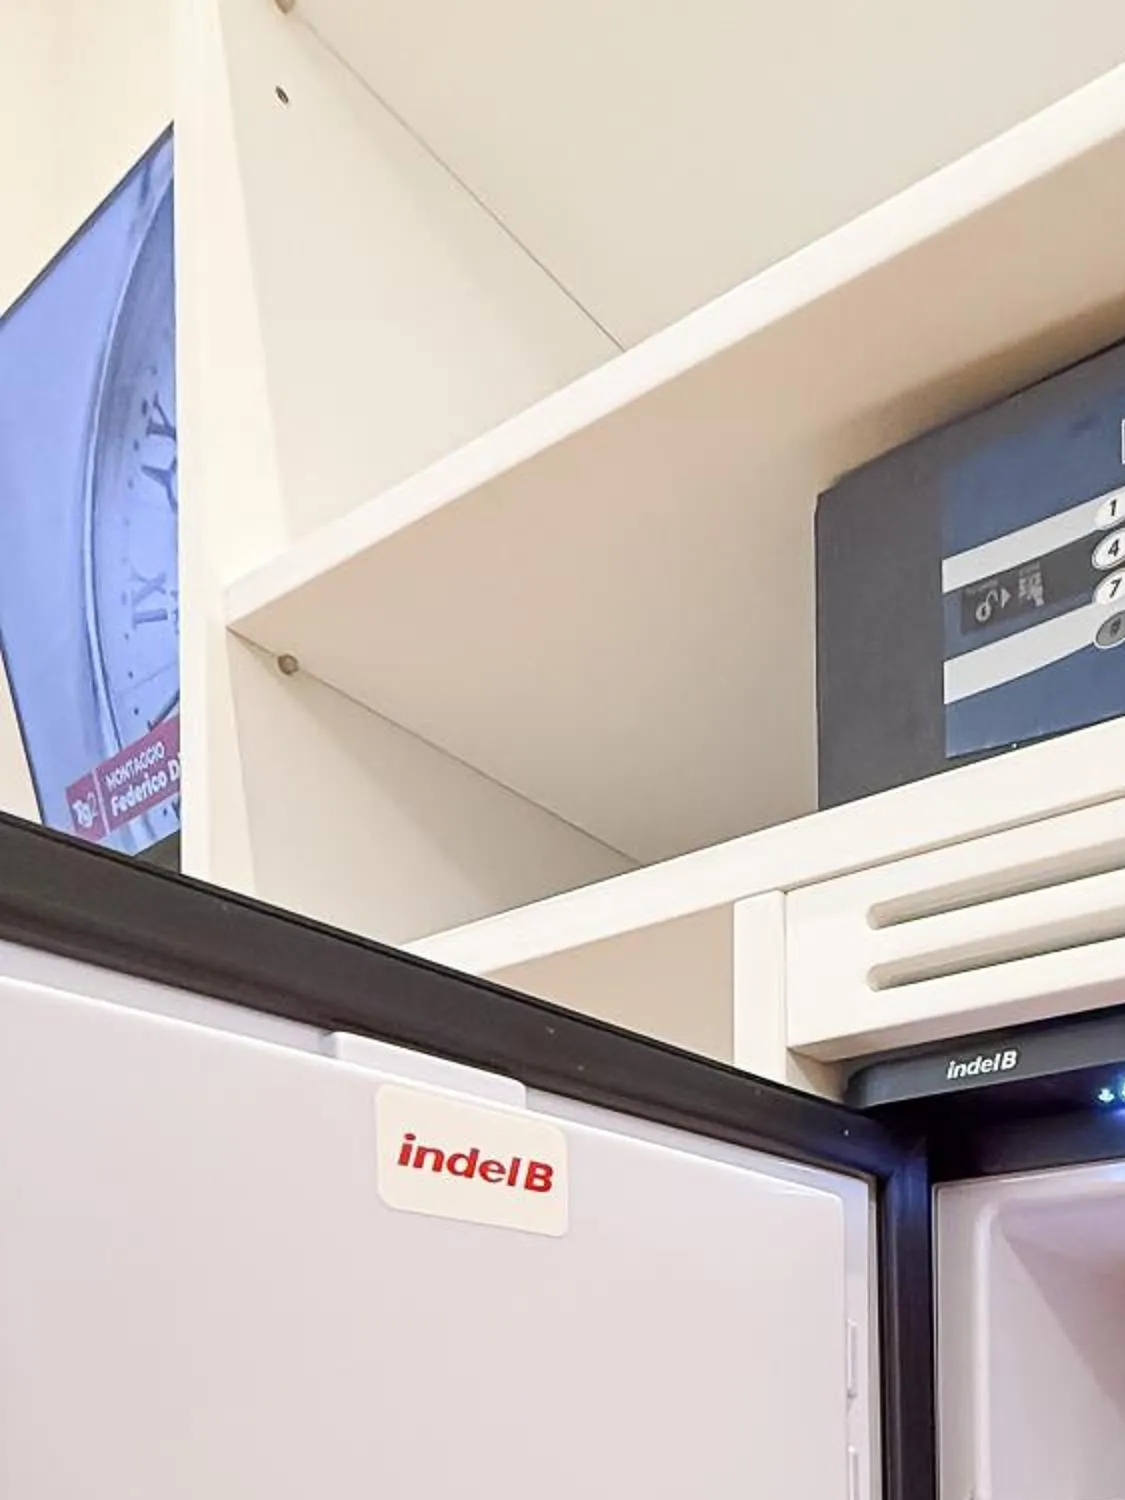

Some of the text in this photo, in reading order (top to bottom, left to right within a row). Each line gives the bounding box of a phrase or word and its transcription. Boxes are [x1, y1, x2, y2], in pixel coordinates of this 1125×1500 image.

[1108, 499, 1118, 517] 1
[1107, 539, 1120, 557] 4
[1109, 577, 1122, 598] 7
[105, 741, 165, 792] MONTAGGIO
[111, 771, 168, 817] Federico
